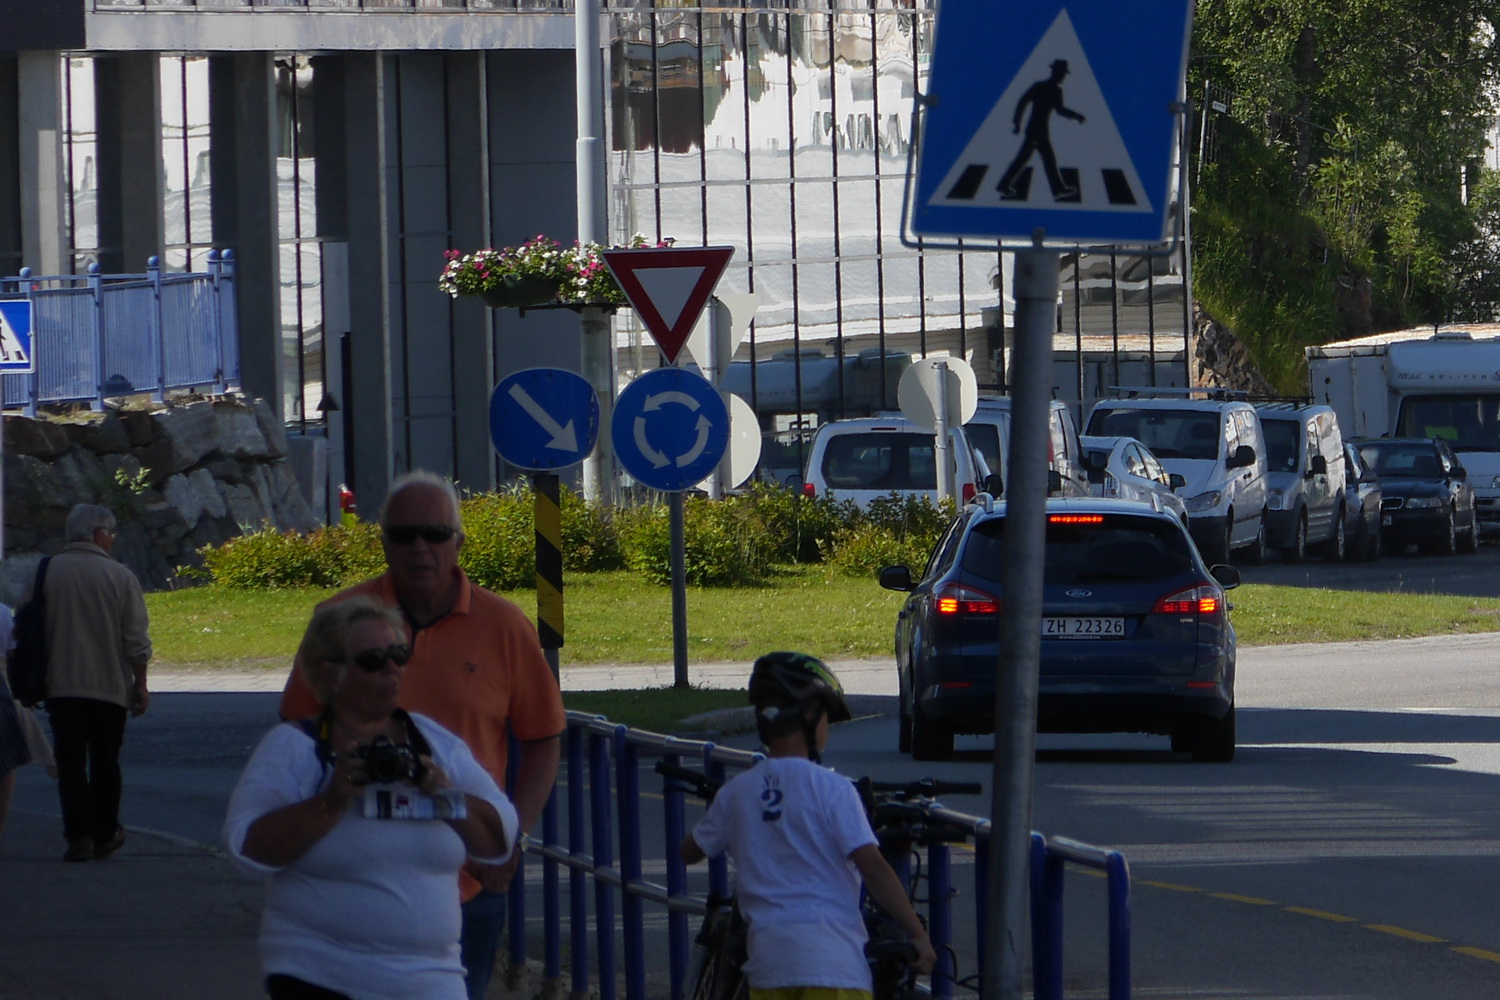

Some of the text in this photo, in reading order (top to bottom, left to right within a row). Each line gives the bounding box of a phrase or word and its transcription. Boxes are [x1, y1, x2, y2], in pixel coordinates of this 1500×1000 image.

[1047, 619, 1122, 633] ZH 22326
[761, 789, 783, 822] 2
